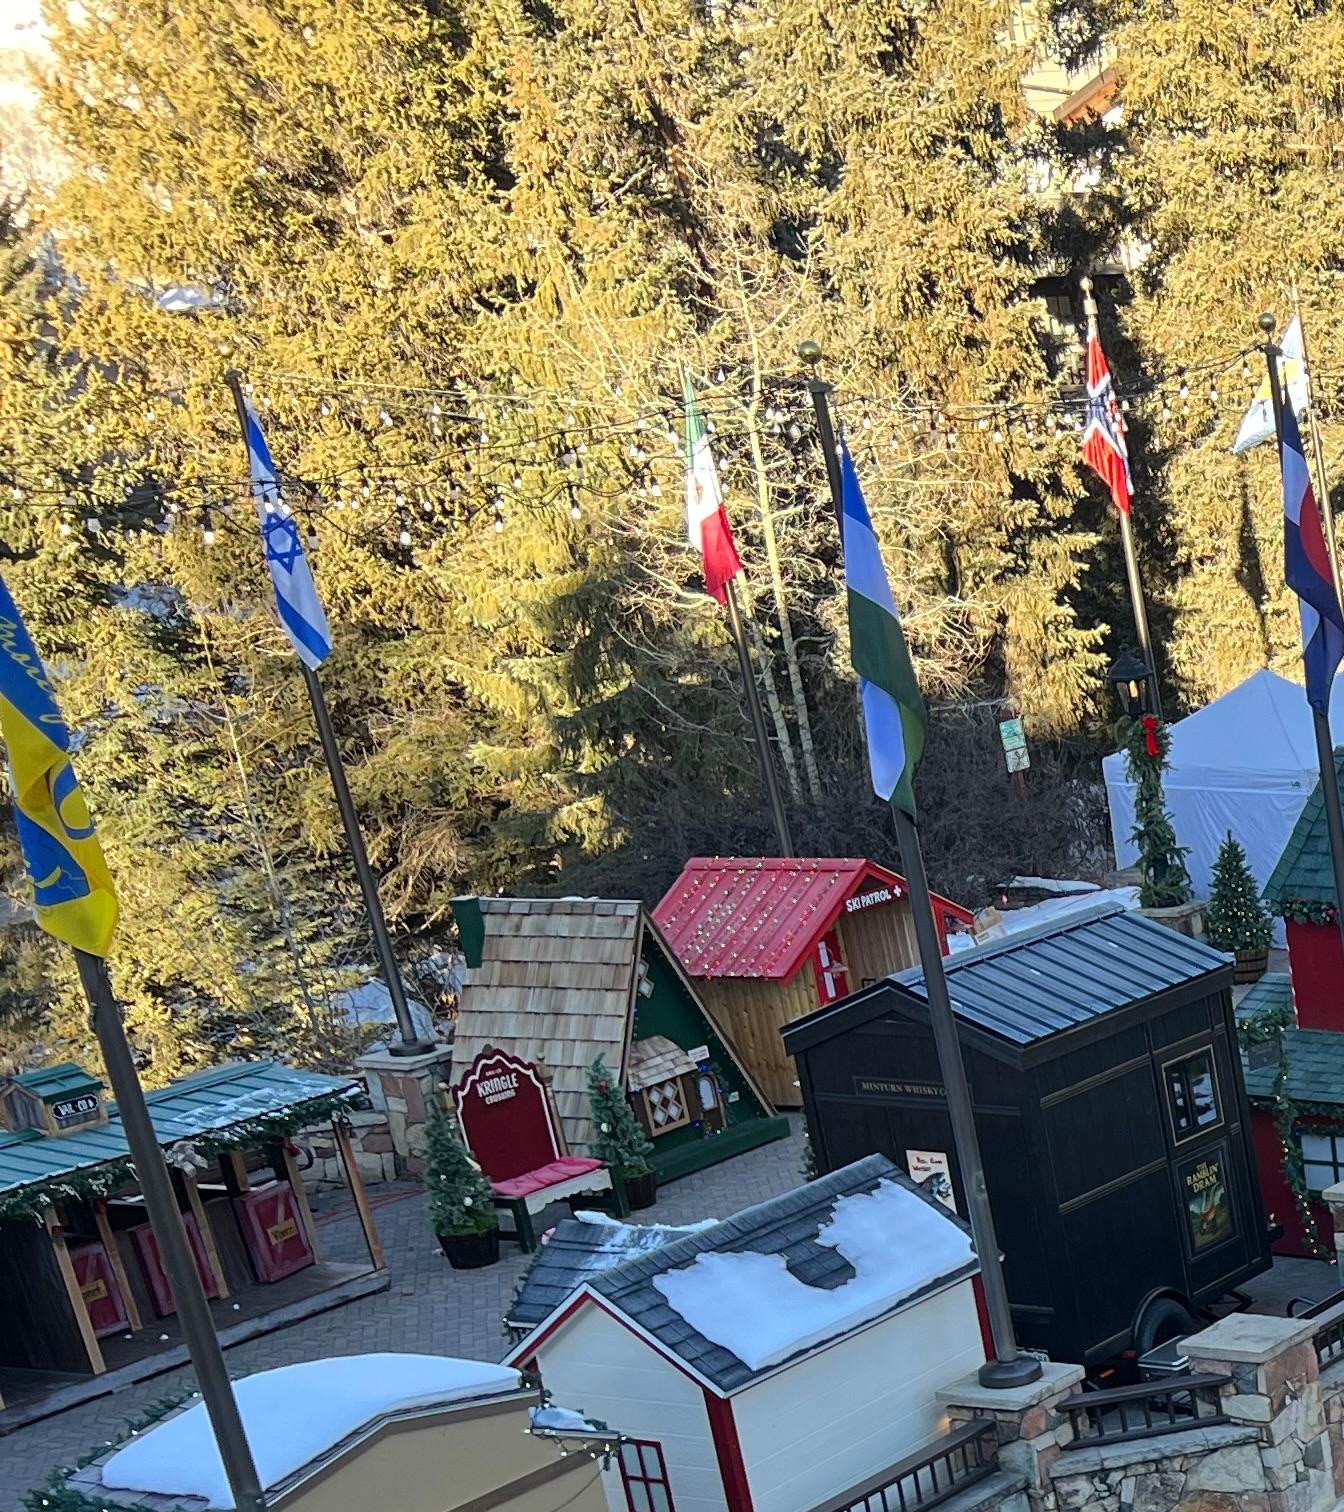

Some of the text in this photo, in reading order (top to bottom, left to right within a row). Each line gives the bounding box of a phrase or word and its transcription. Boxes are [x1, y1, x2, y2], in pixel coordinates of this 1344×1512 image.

[846, 888, 892, 912] SKI PATROL
[476, 1072, 519, 1098] KRINGLE
[862, 1081, 902, 1093] MINTURN
[903, 1085, 939, 1096] WHISKY
[1192, 1174, 1217, 1193] DRAM
